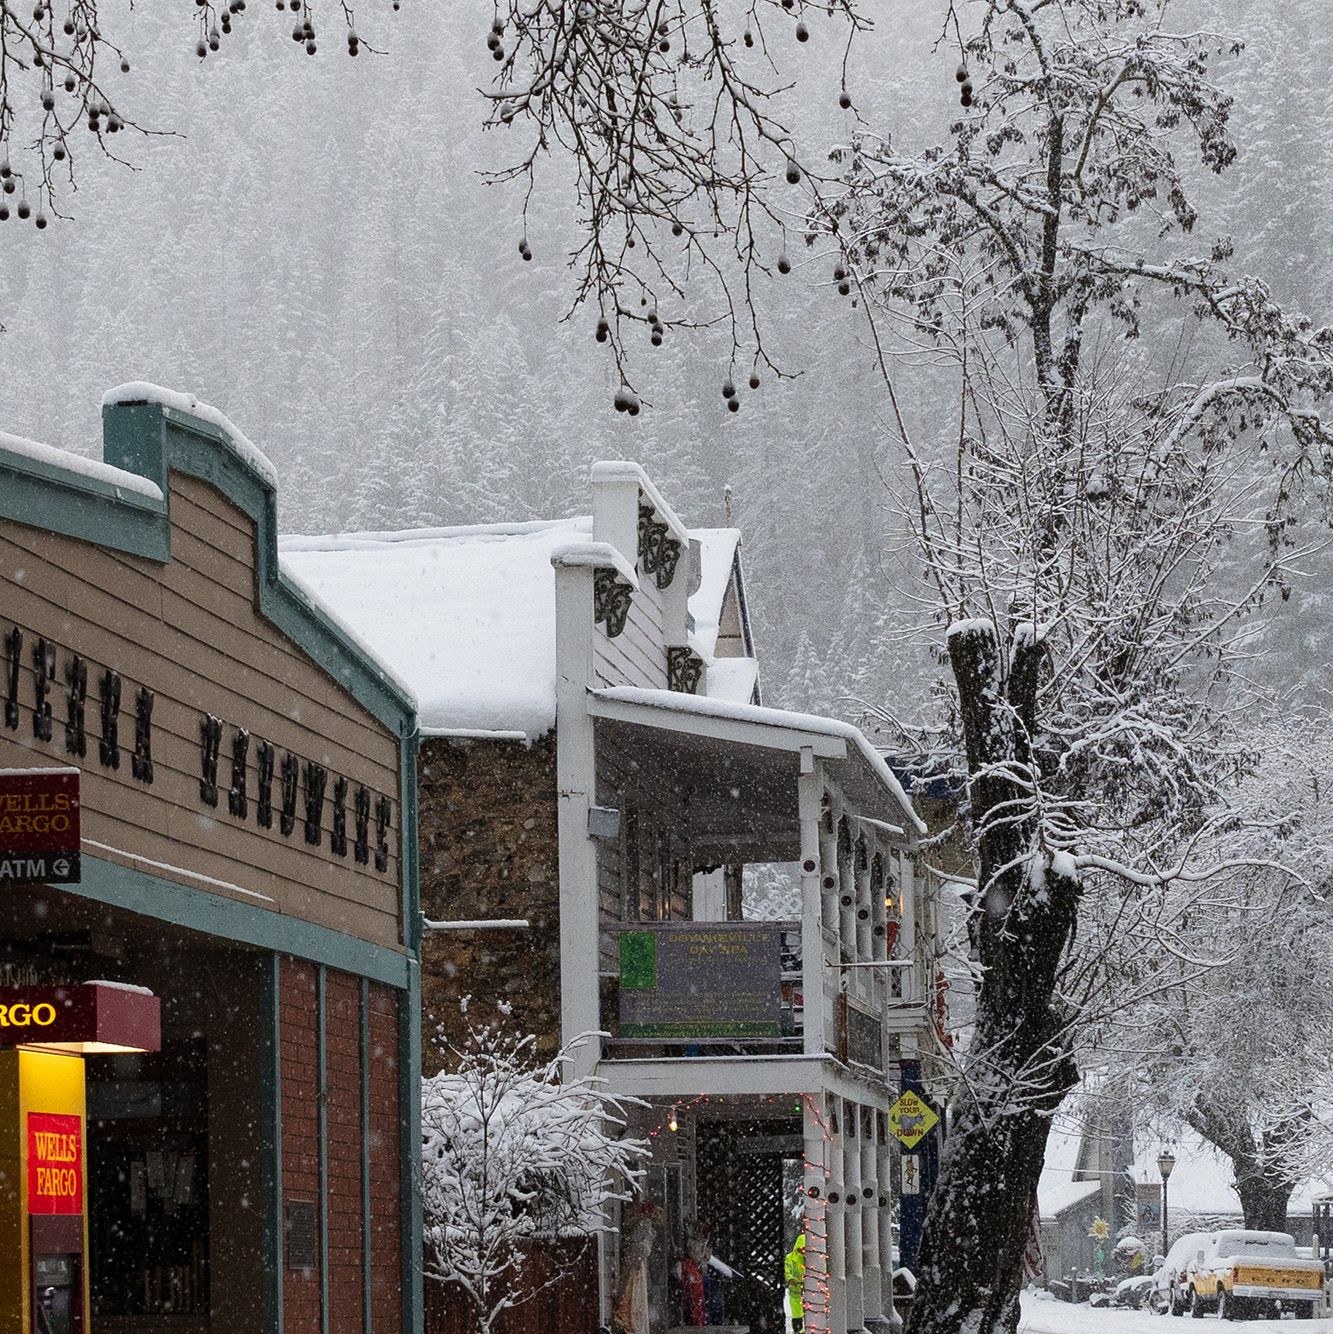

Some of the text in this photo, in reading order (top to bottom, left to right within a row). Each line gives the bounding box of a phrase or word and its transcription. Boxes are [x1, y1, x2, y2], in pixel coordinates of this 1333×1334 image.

[0, 794, 71, 812] ELLS
[0, 859, 46, 878] ATM
[668, 933, 770, 943] DOWNIEVILLE
[899, 1106, 920, 1114] YOUR
[896, 1128, 924, 1137] DOWN
[34, 1132, 77, 1163] WELLS
[36, 1167, 77, 1198] FARGO
